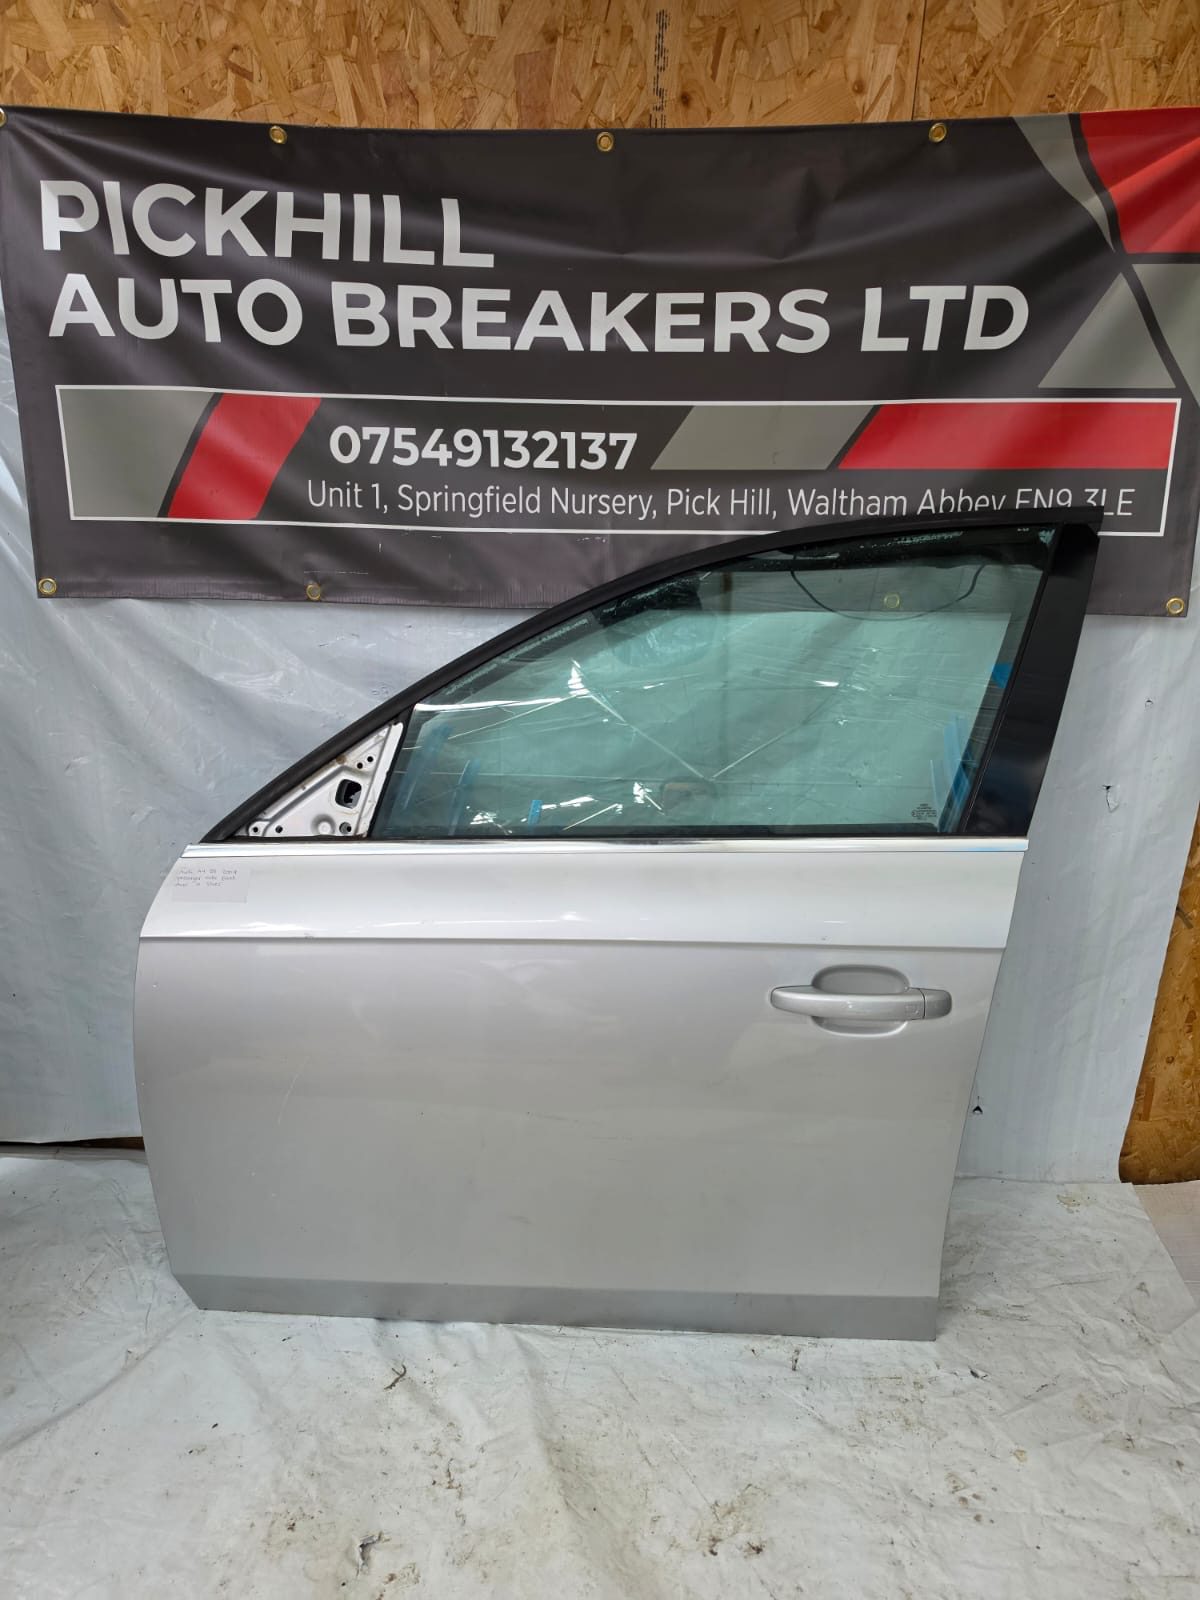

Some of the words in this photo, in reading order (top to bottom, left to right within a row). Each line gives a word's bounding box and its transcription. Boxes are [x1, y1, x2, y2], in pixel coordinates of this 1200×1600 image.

[39, 179, 495, 269] PICKHILL
[48, 273, 303, 346] AUTO
[331, 281, 830, 354] BREAKERS
[860, 285, 1029, 352] LTD
[329, 425, 638, 470] 07549132137
[308, 479, 363, 510] Unit
[371, 482, 388, 514] 1,
[397, 483, 541, 519] Springfield
[551, 486, 657, 521] Nursery,
[667, 487, 721, 516] Pick
[730, 487, 777, 520] Hill,
[787, 487, 908, 516] Waltham
[916, 488, 1006, 515] Abbey
